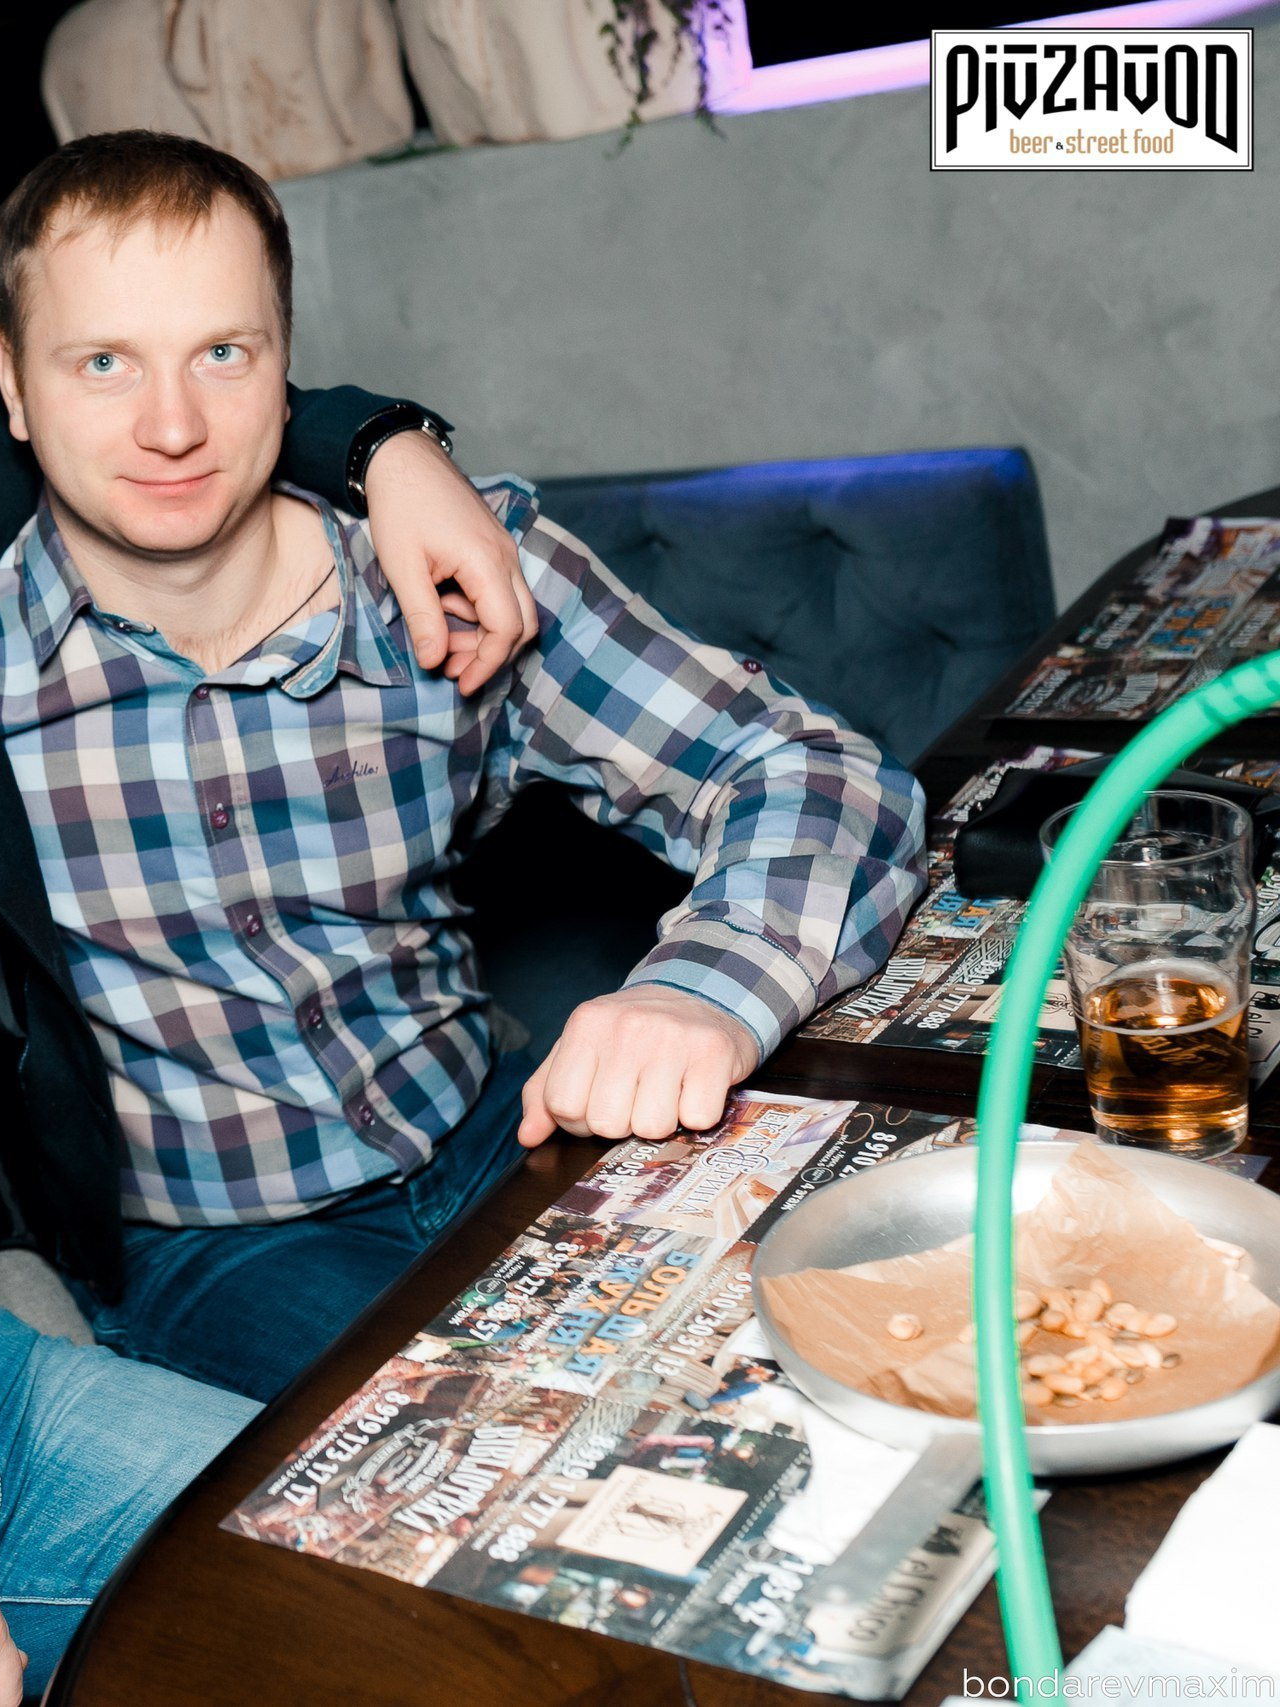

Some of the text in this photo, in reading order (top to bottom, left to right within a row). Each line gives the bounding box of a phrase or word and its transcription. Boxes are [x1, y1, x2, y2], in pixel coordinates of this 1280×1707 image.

[936, 991, 969, 1011] 777
[916, 1009, 950, 1030] 888
[870, 1131, 898, 1142] 8
[850, 1141, 890, 1166] 910
[779, 1189, 807, 1210] этаж
[552, 1241, 579, 1253] 8
[528, 1250, 569, 1277] 910
[546, 1263, 646, 1347] КУХНЯ
[708, 1281, 753, 1309] 910
[447, 1302, 478, 1324] этаж
[563, 1249, 702, 1375] БОЛЬШАЯ
[465, 1319, 503, 1340] 57
[381, 1390, 413, 1405] 8
[351, 1401, 403, 1434] 919
[321, 1430, 372, 1463] 173
[299, 1459, 341, 1484] 17
[389, 1416, 527, 1531] BIBLIOTEKA
[277, 1481, 318, 1505] 17
[513, 1491, 569, 1527] 777
[481, 1523, 542, 1562] 888
